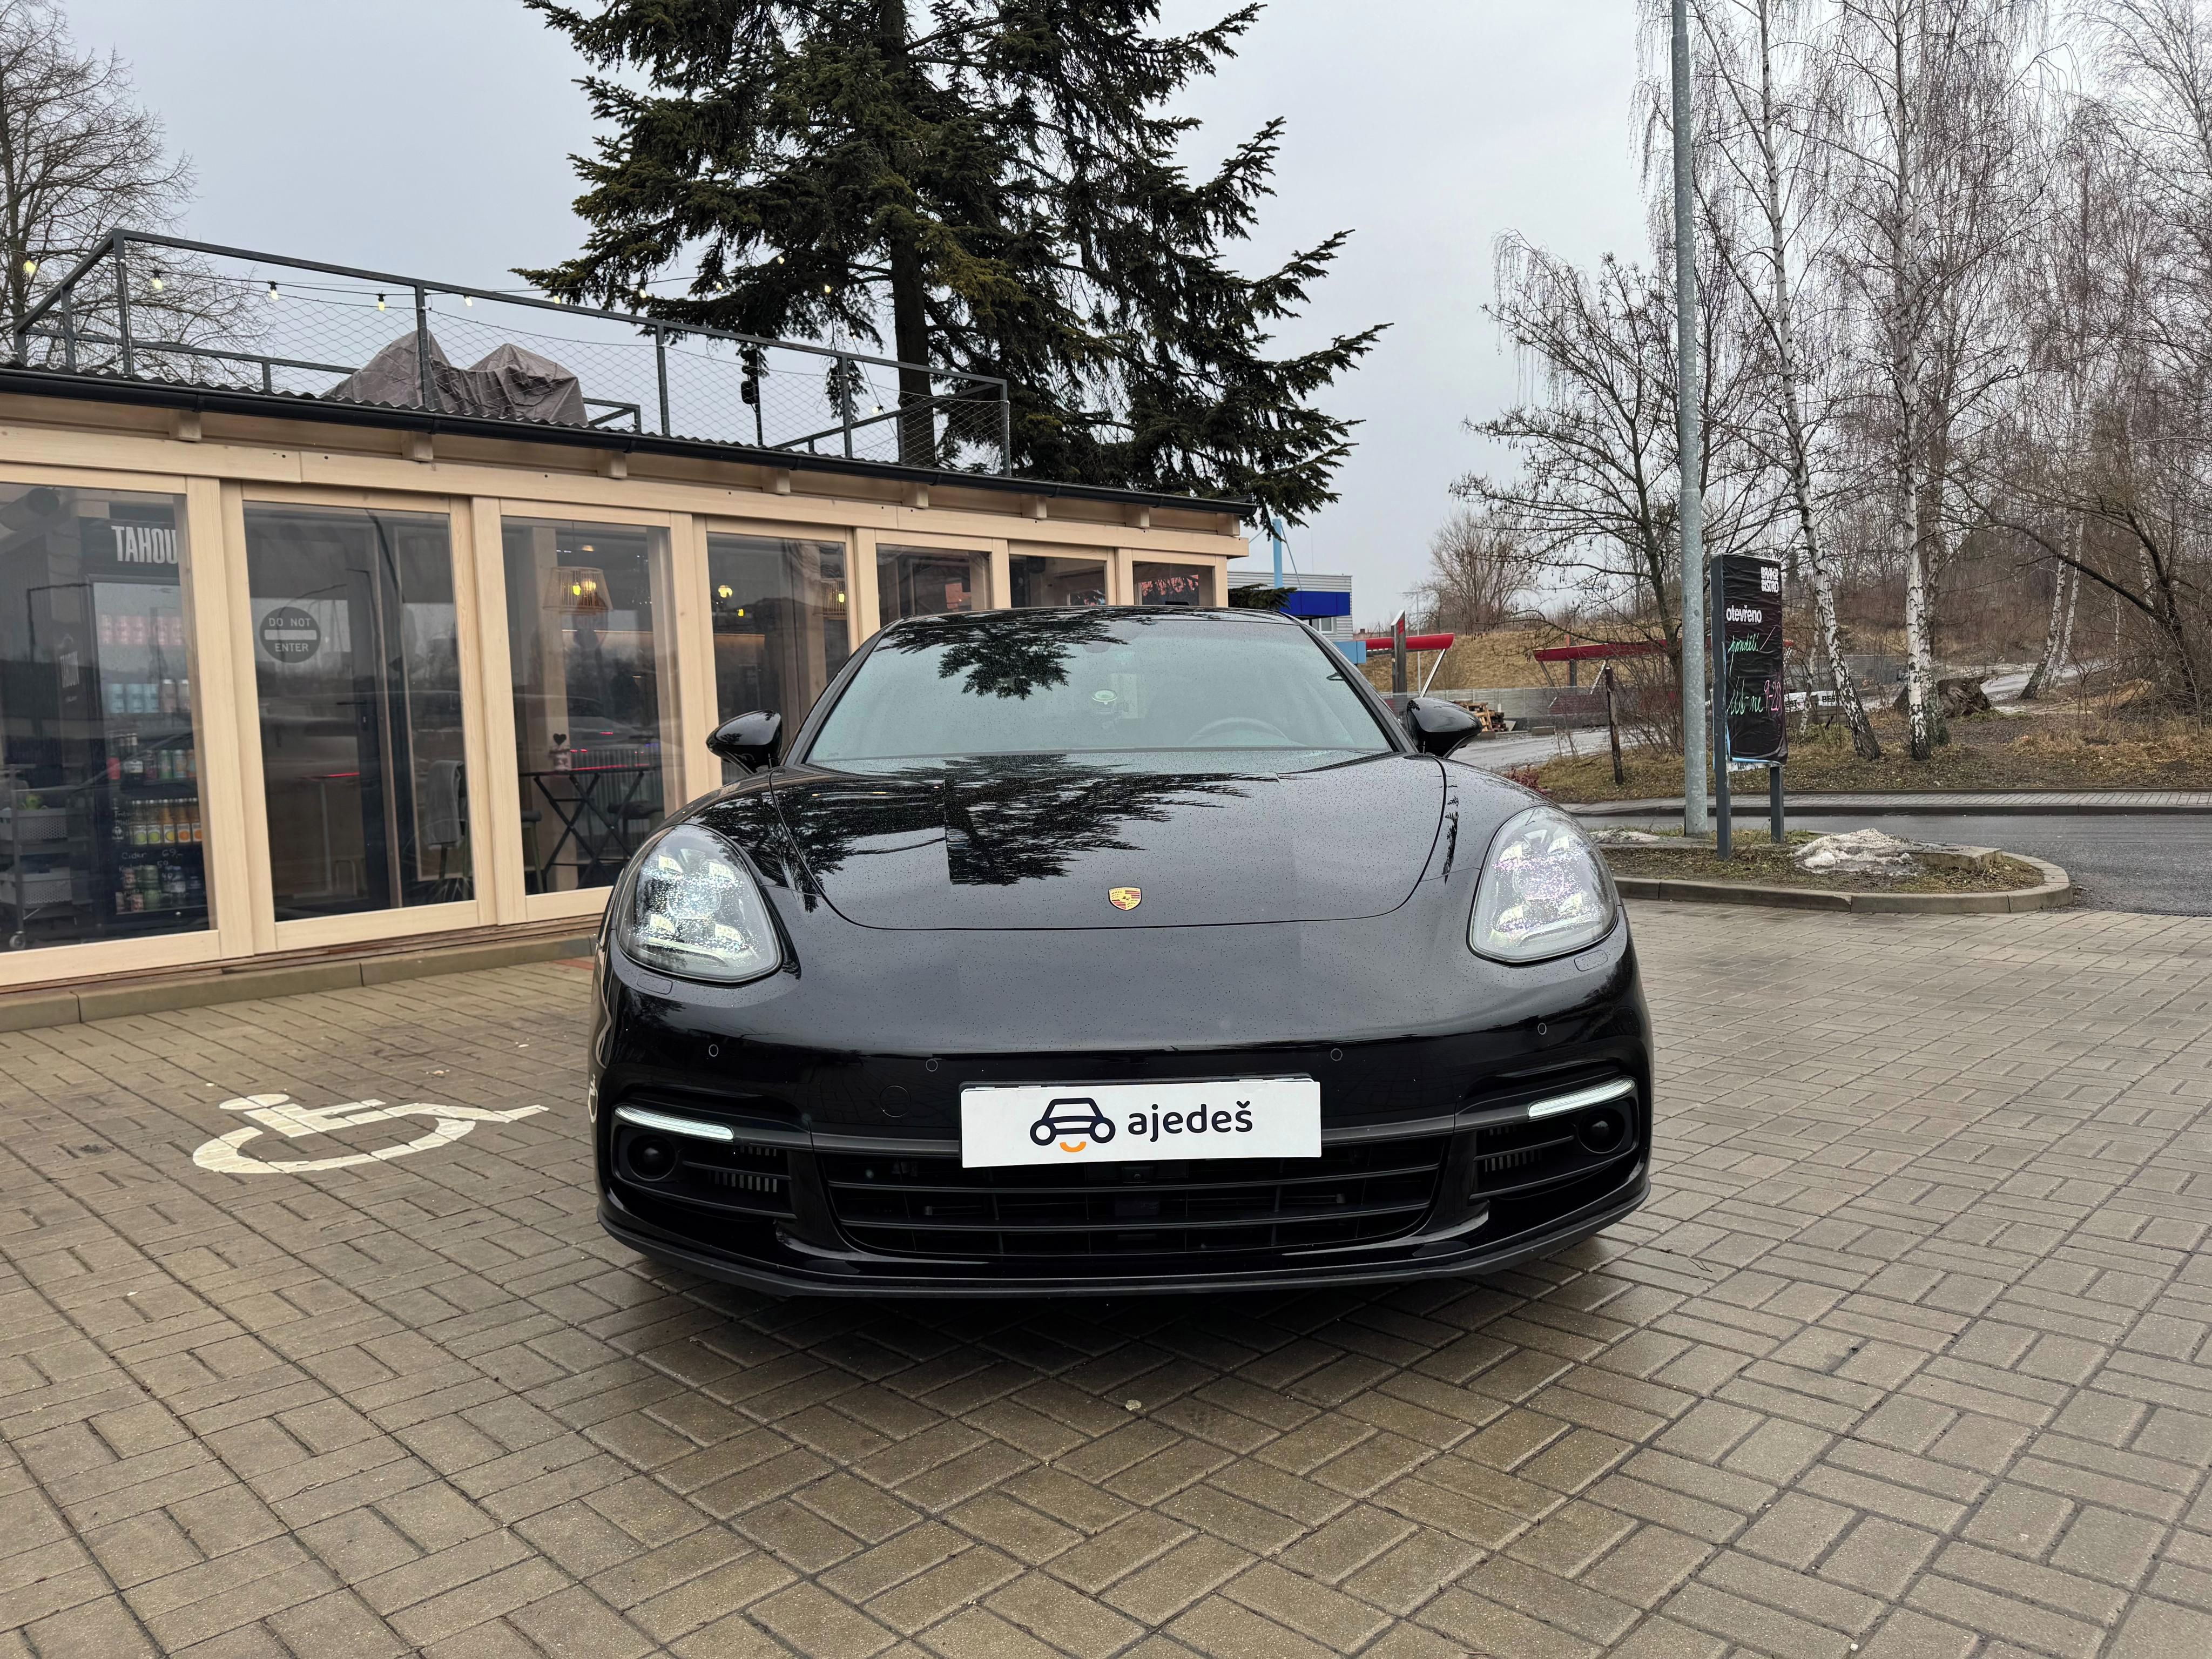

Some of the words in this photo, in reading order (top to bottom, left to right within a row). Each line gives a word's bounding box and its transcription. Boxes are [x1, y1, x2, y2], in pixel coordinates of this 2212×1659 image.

[1726, 604, 1762, 623] otevřeno
[269, 617, 284, 627] DO
[291, 618, 311, 627] NOT
[274, 643, 309, 652] ENTER
[1128, 1100, 1253, 1143] ajedeš
